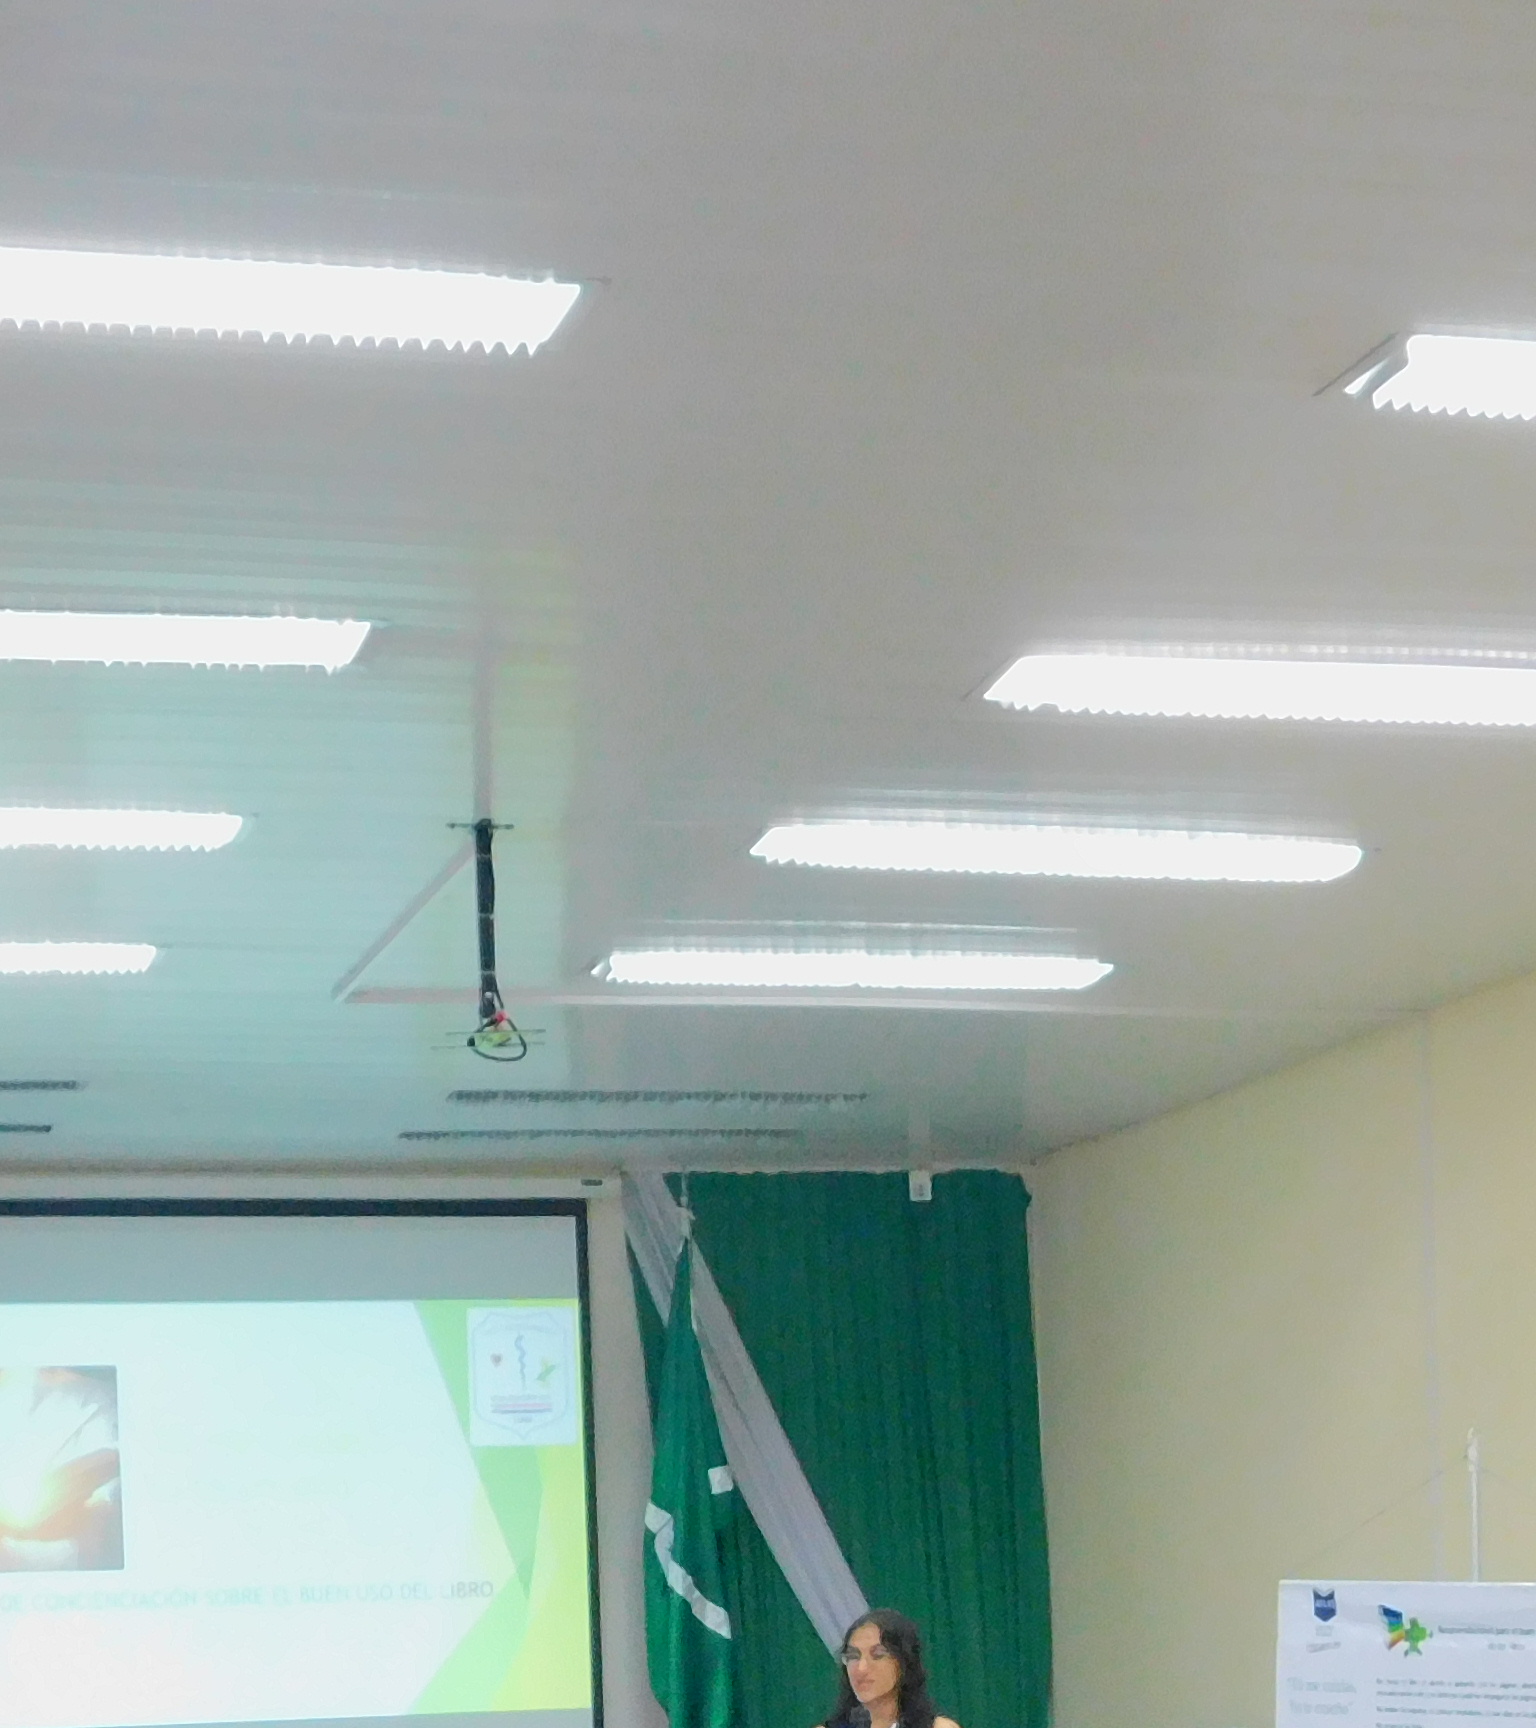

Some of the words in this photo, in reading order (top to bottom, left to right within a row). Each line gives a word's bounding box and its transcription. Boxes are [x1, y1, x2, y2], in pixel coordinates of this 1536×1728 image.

[205, 1585, 265, 1606] SOBRE
[273, 1585, 292, 1604] EL
[300, 1583, 350, 1603] BUEN
[357, 1583, 393, 1602] USO
[400, 1582, 433, 1600] DEL
[441, 1580, 495, 1600] LIBRO
